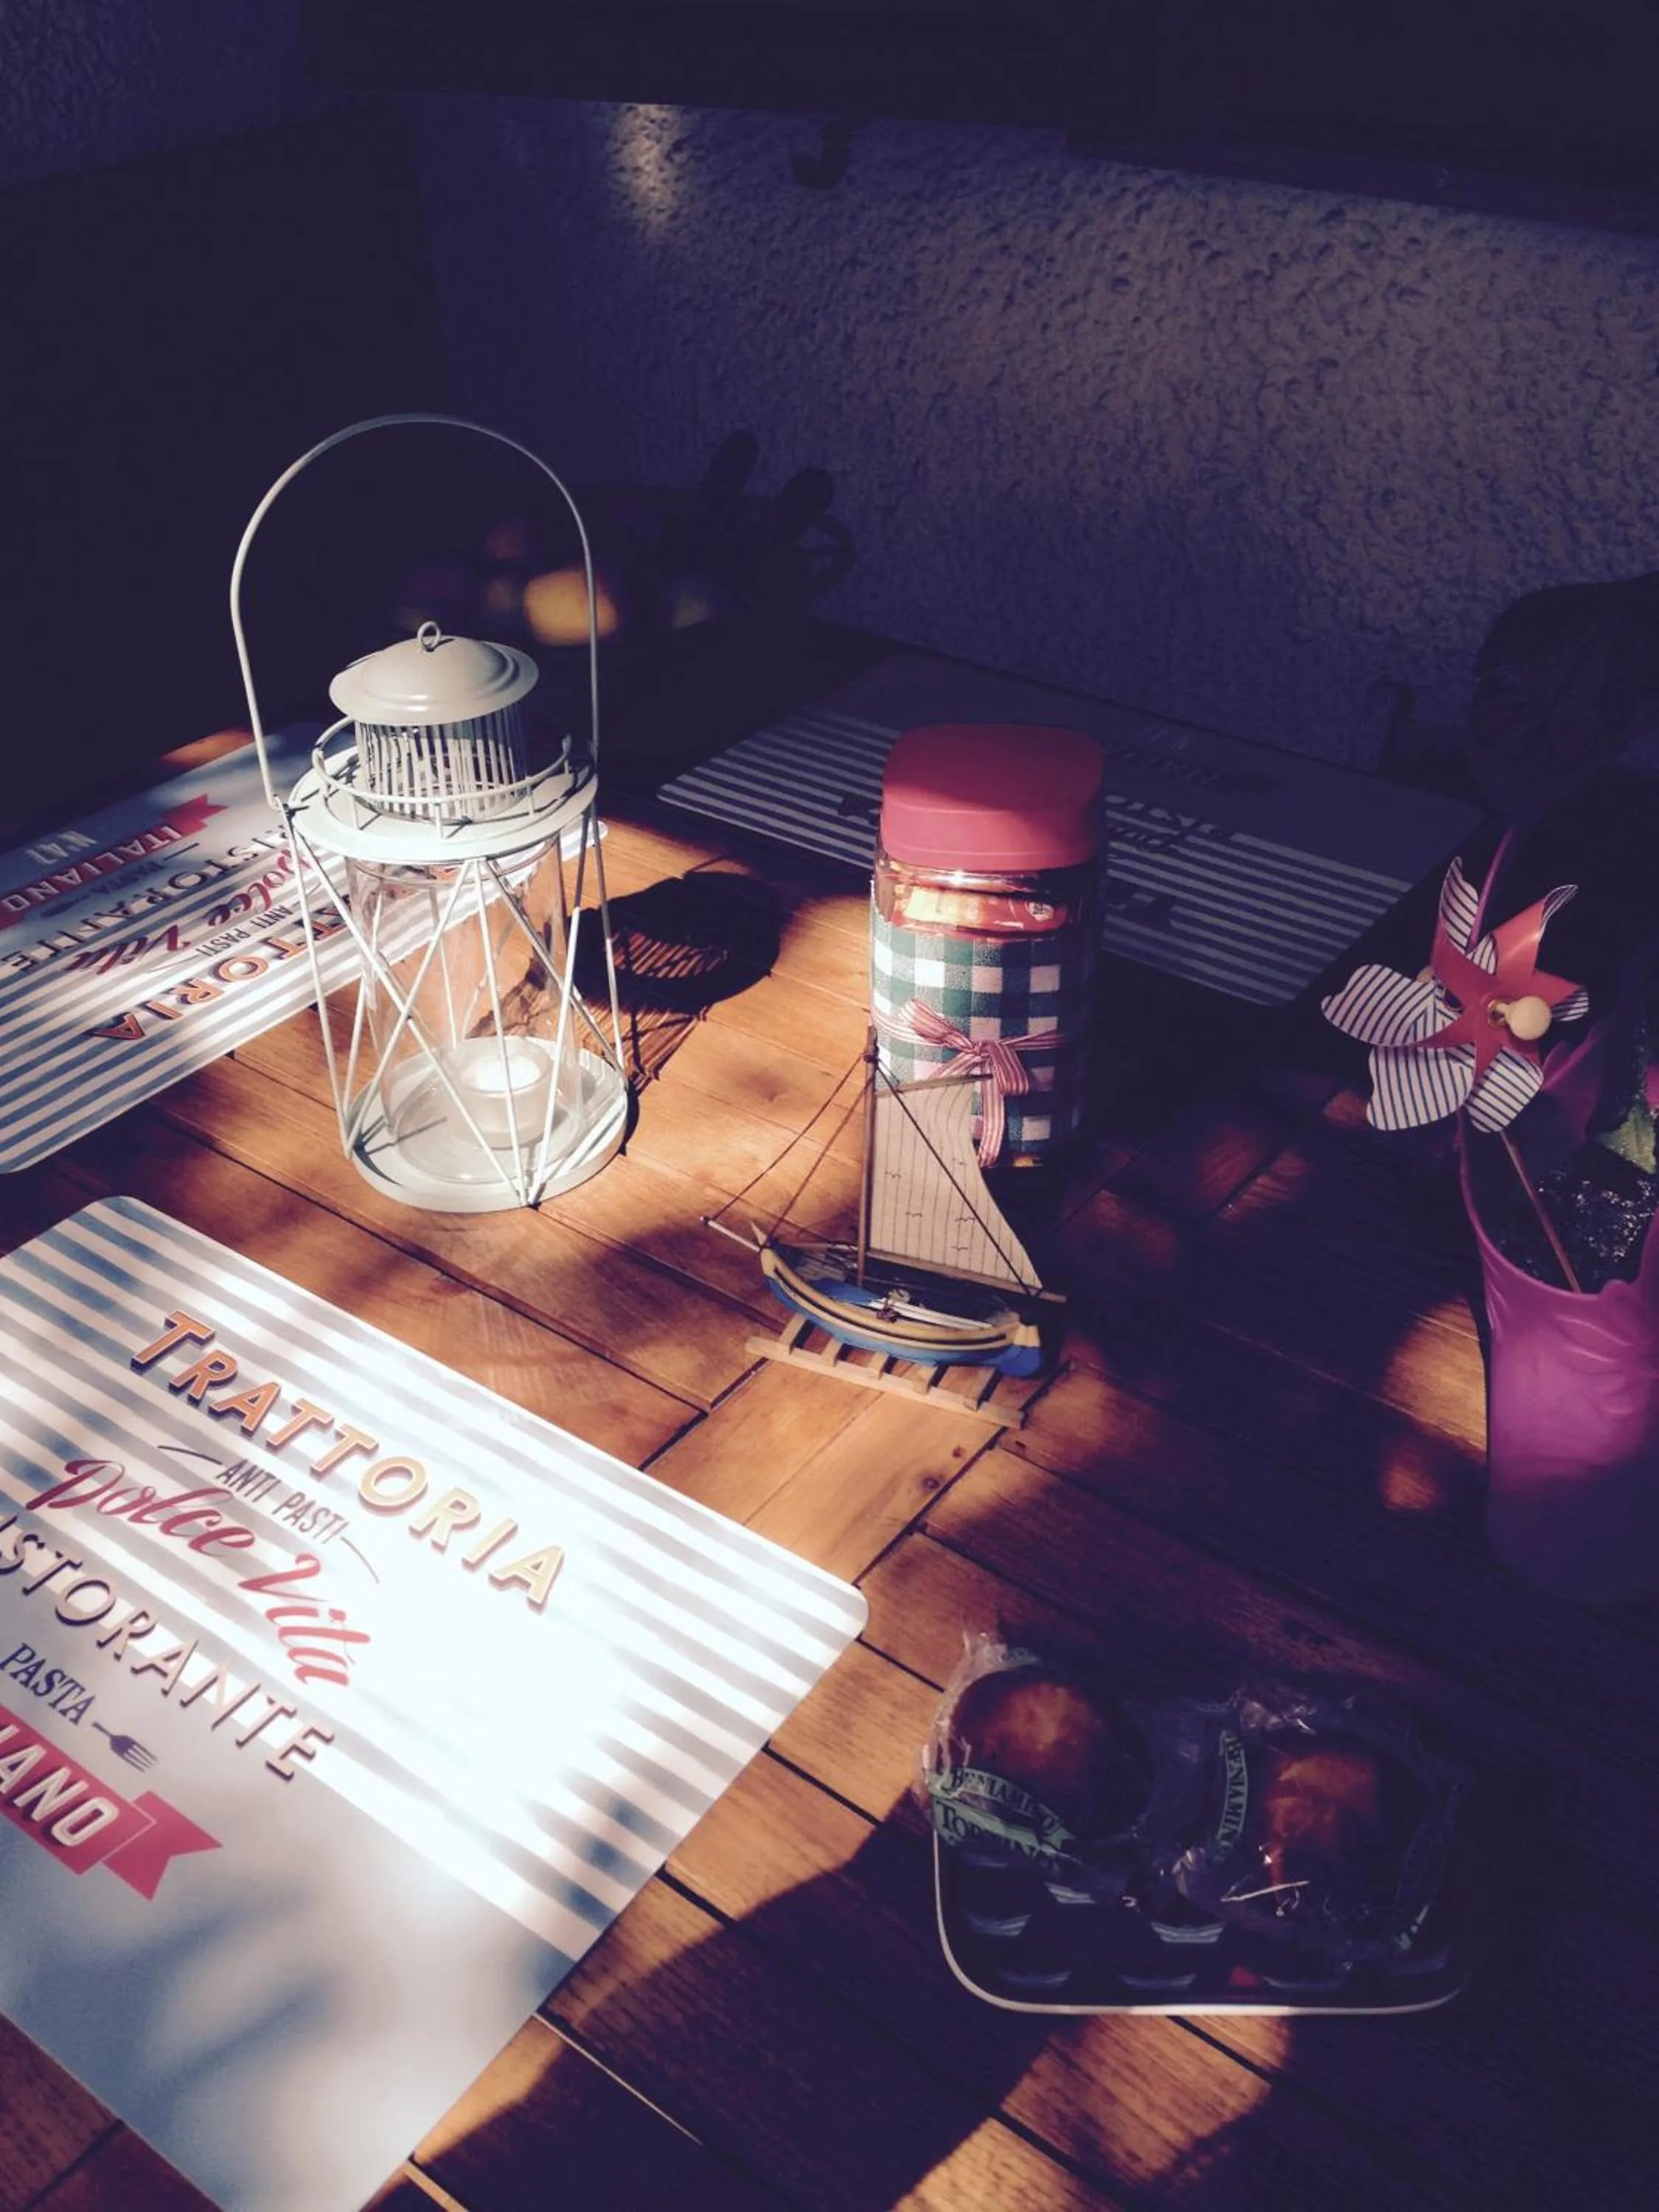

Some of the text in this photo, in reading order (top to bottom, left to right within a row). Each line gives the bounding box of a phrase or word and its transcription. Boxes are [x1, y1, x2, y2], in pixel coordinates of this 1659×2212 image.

[1, 824, 184, 913] ITALIANO
[64, 847, 313, 975] Dolce Vita
[85, 886, 355, 1042] ATTORIA
[195, 904, 294, 958] ANTI PASTI
[130, 1310, 566, 1613] TRATTORIA
[216, 1457, 351, 1547] ANTI PASTI
[26, 1458, 371, 1688] Dolce Vita
[0, 1514, 335, 1782] STORANTE
[0, 1642, 97, 1726] PASTA
[948, 1766, 1057, 1833] BENIAMIO
